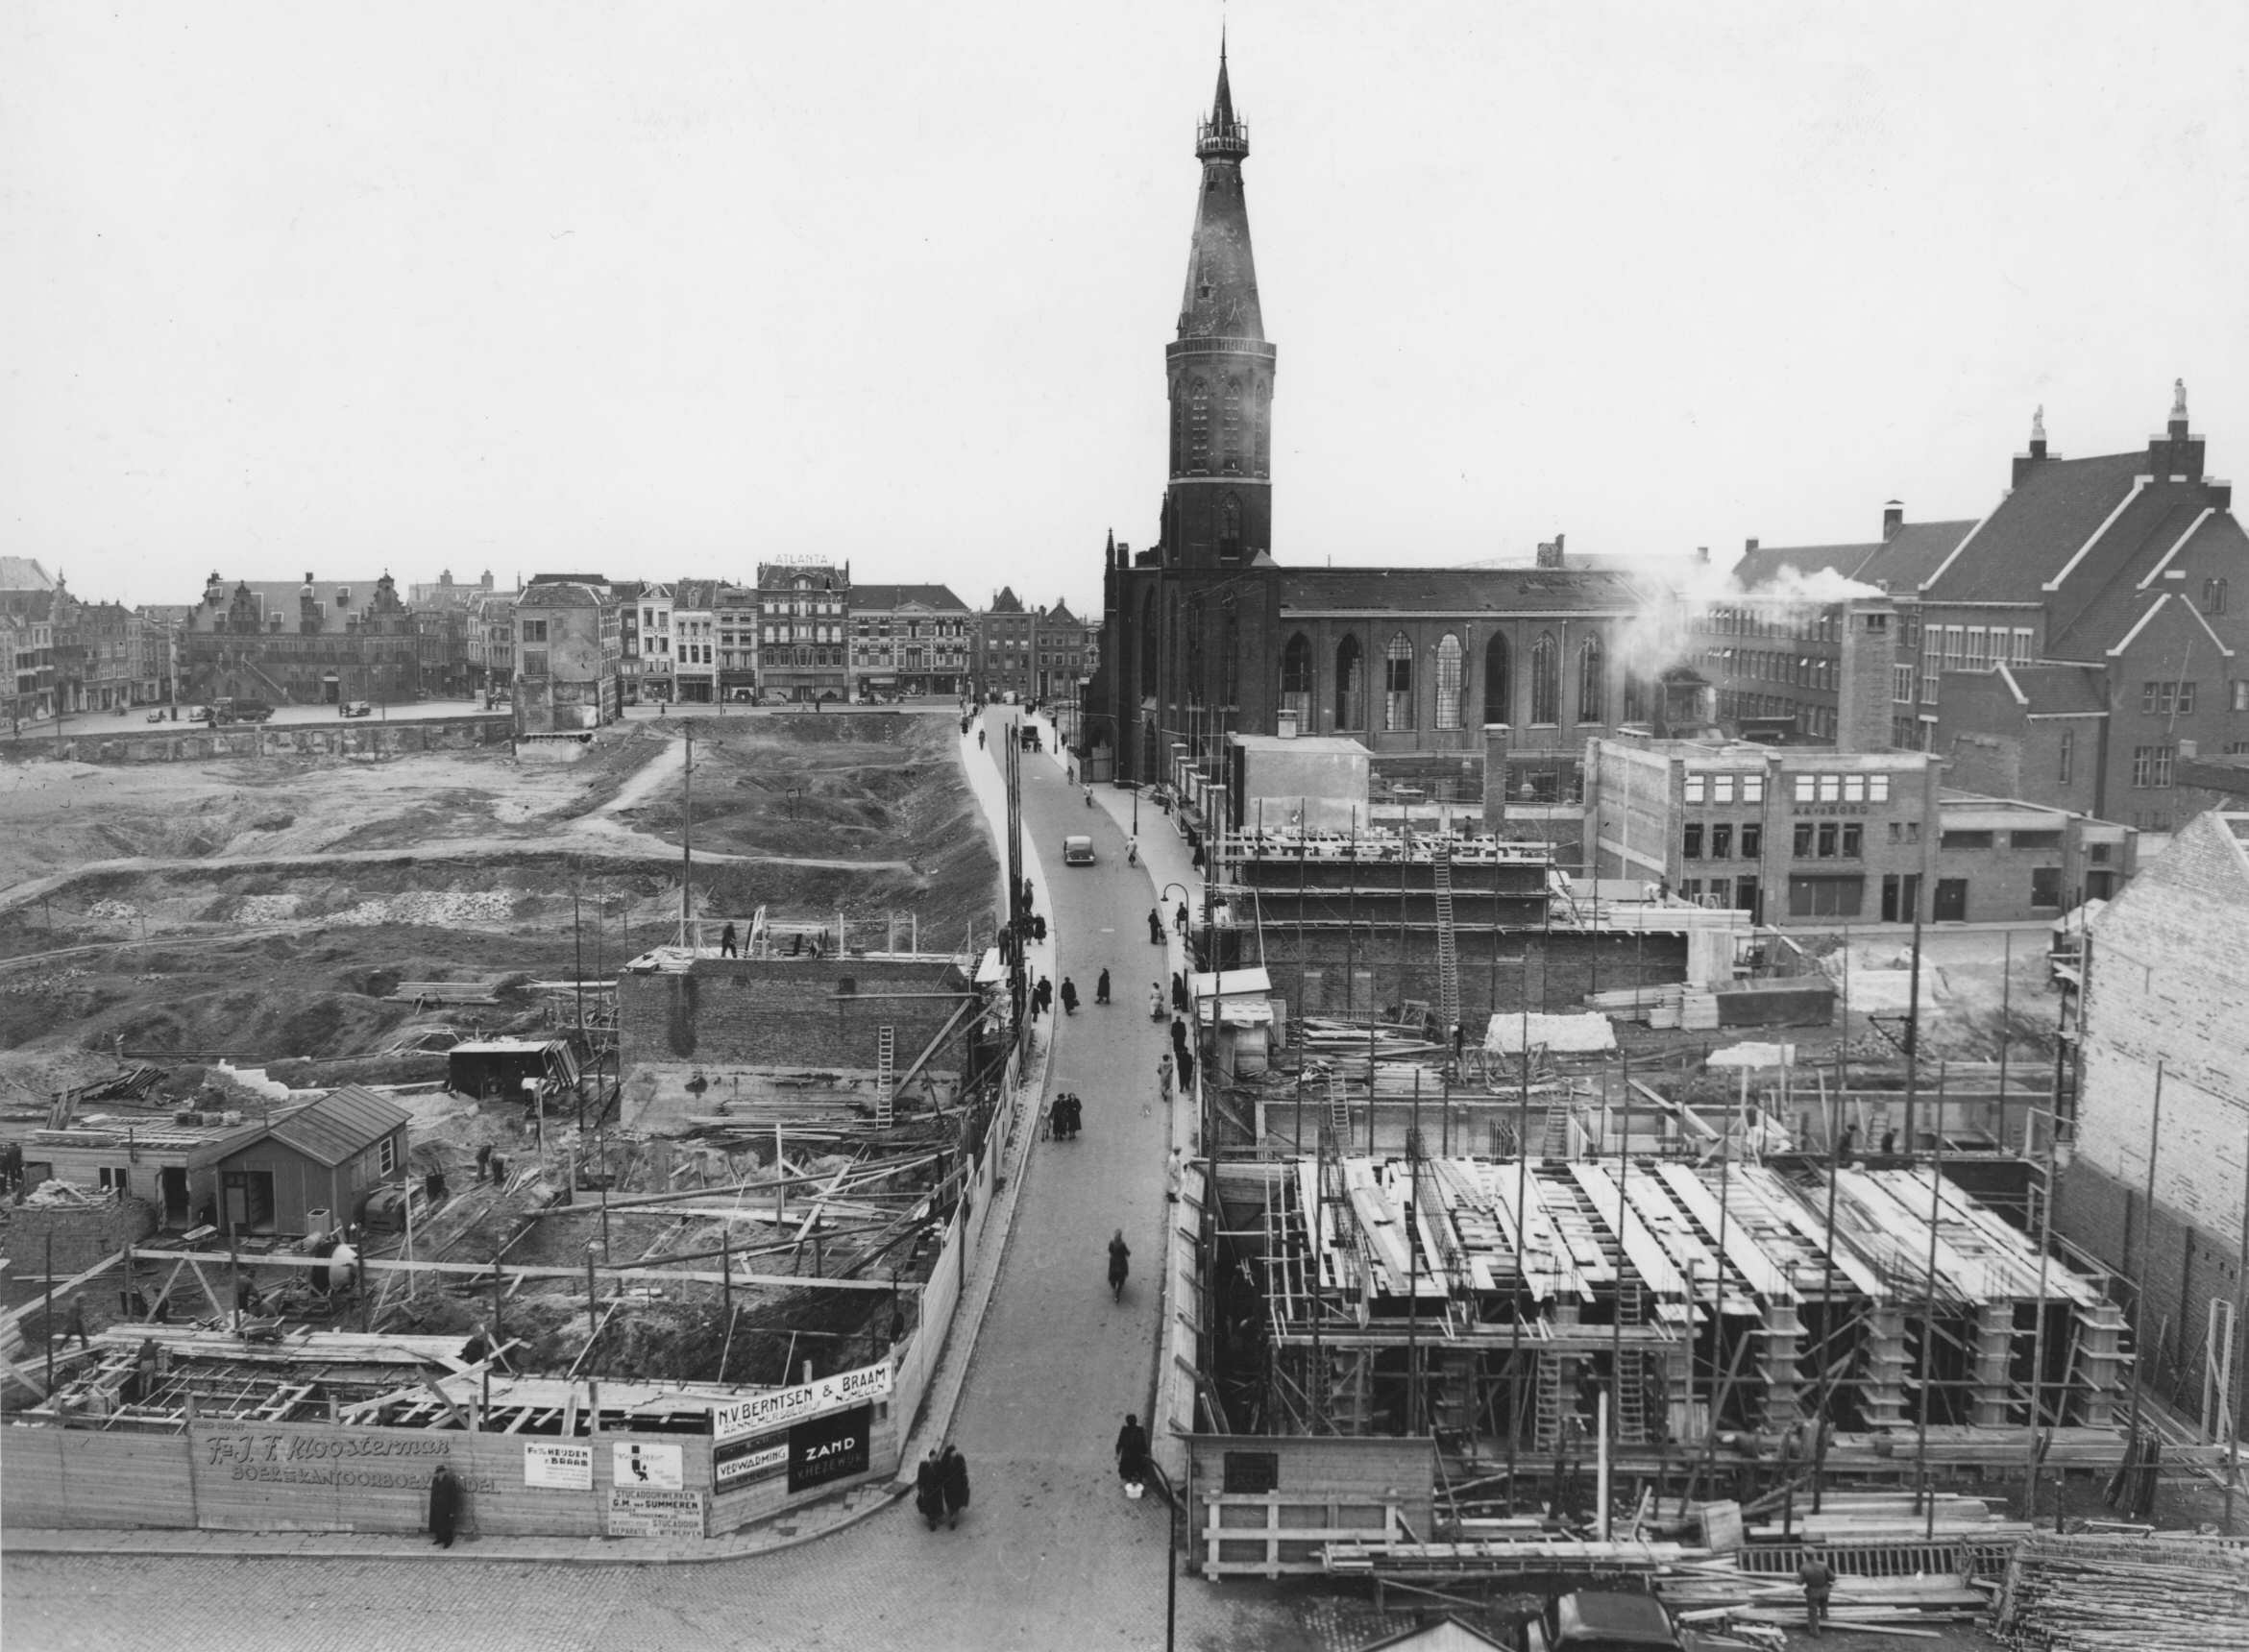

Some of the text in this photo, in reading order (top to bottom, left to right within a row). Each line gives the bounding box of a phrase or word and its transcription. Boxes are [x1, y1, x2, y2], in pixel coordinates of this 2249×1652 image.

[774, 553, 828, 565] ATLANTA
[743, 1387, 814, 1419] BERNTSEN
[822, 1383, 833, 1397] &
[843, 1367, 886, 1392] BRAAM
[806, 1437, 856, 1461] ZAND
[720, 1447, 786, 1476] VERWARMING
[645, 1500, 698, 1509] SUMMEREN
